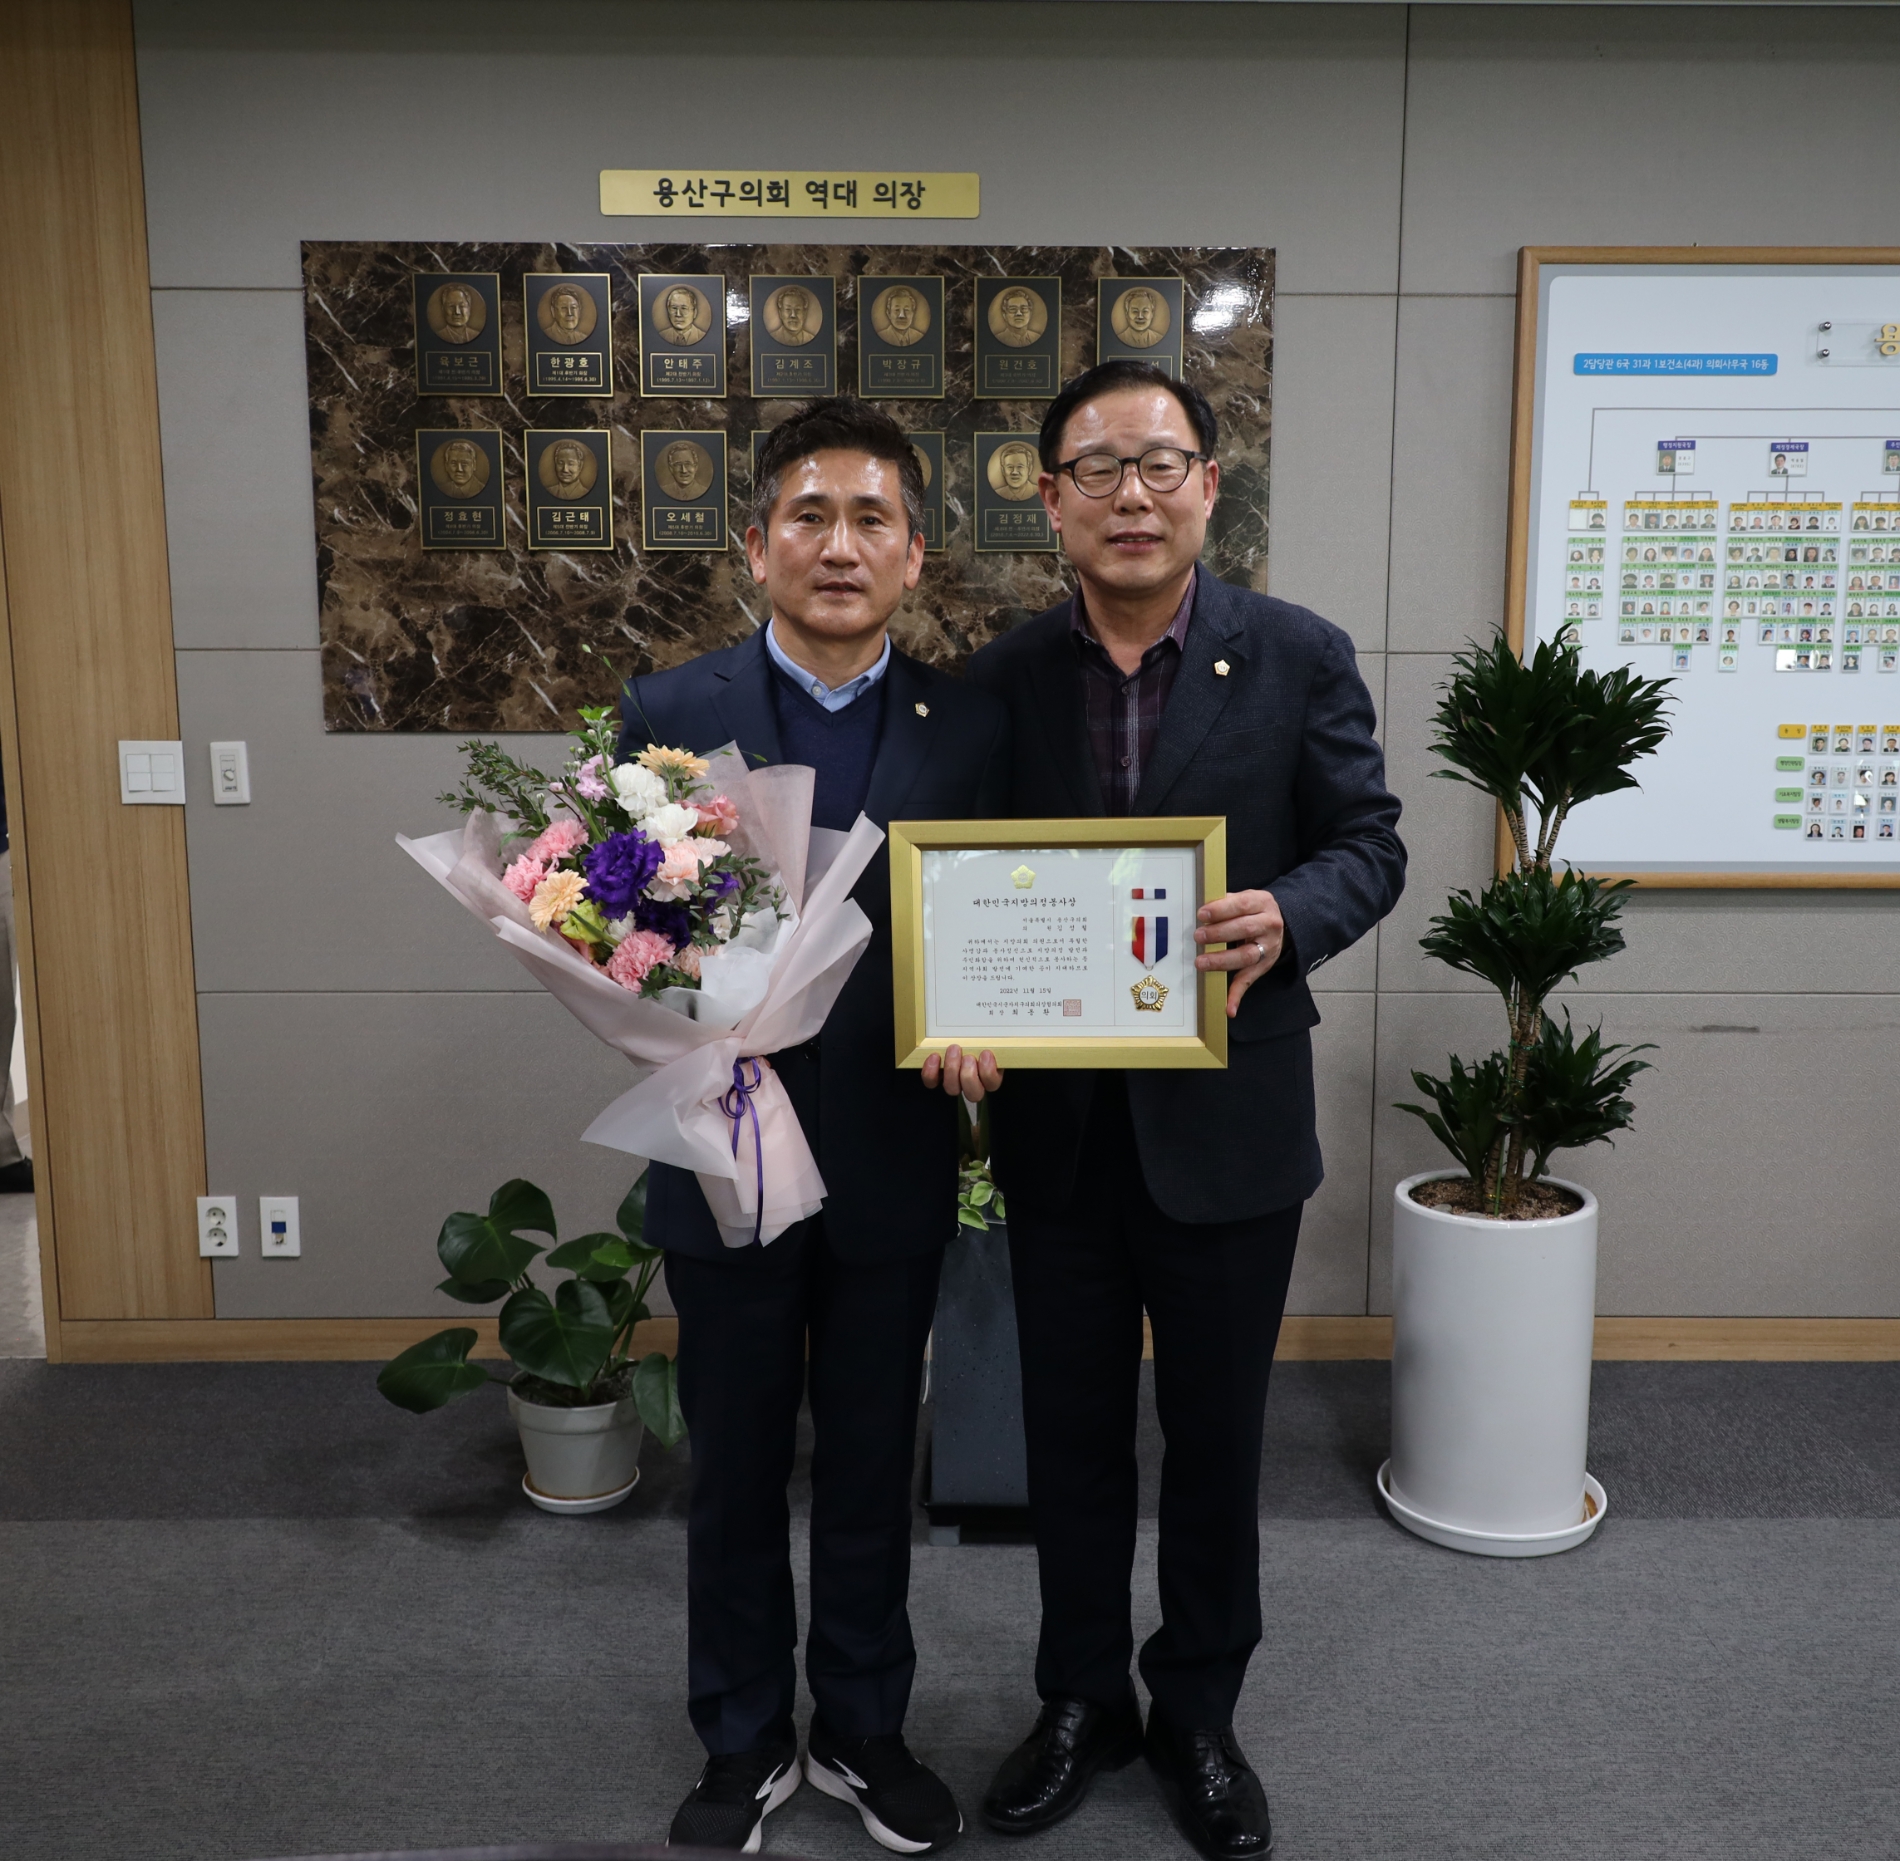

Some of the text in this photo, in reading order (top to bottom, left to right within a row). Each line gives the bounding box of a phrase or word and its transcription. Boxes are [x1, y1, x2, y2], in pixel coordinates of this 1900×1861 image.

[652, 177, 926, 210] 용산구의회 역대 의장
[440, 356, 478, 368] 육보근
[550, 356, 589, 368] 한광호
[664, 358, 702, 370] 안태주
[775, 358, 813, 370] 김계조
[882, 359, 920, 370] 박장규
[999, 359, 1037, 370] 원건호
[1583, 358, 1769, 370] 2담당관 6국 31과 1보건소(4과) 의회사무국 16동
[444, 511, 482, 522] 정효현
[552, 511, 589, 522] 김근태
[666, 512, 704, 523] 오세철
[999, 514, 1037, 524] 김정재
[972, 897, 1076, 908] 대한민국지방의정봉사상
[1141, 991, 1157, 1000] 의회
